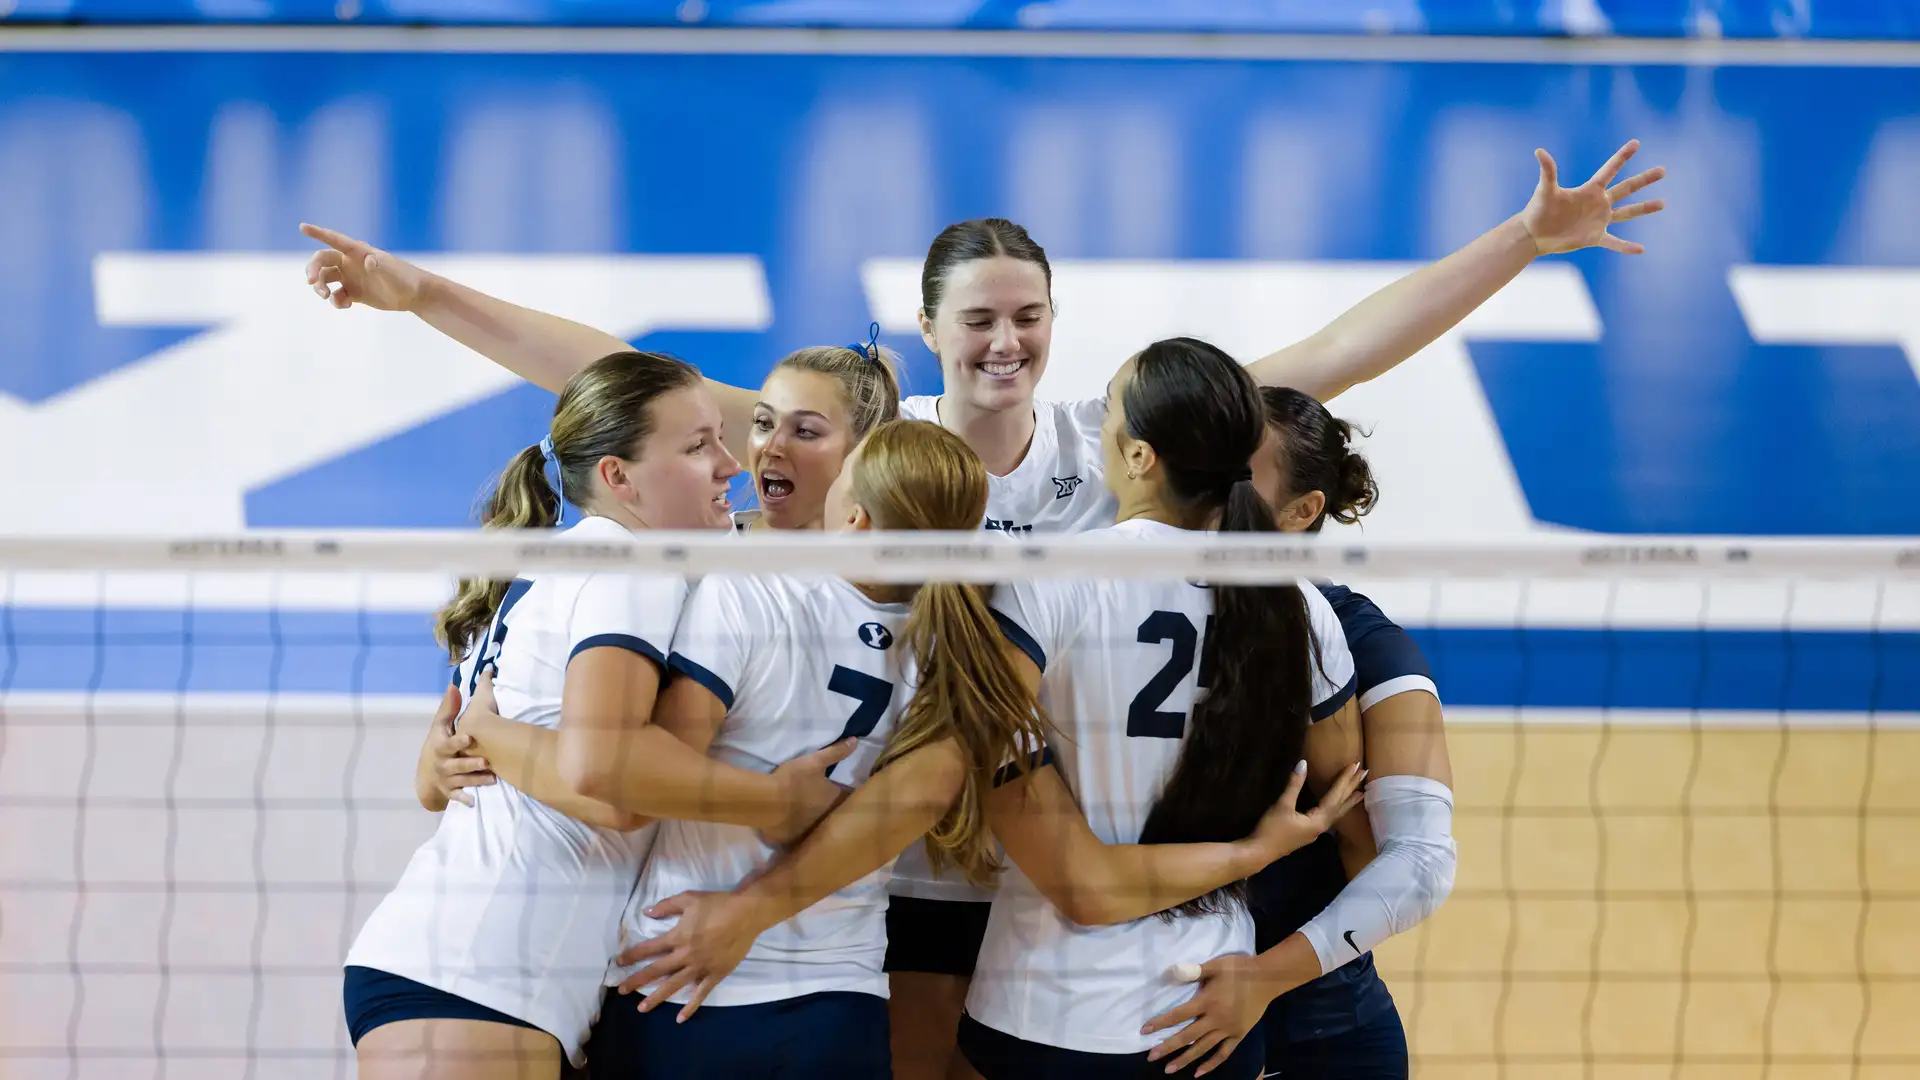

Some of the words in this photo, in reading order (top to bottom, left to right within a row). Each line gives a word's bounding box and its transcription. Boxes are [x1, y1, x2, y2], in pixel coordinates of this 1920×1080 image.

[865, 624, 888, 648] Y
[1127, 610, 1215, 739] 2
[827, 663, 894, 778] 7
